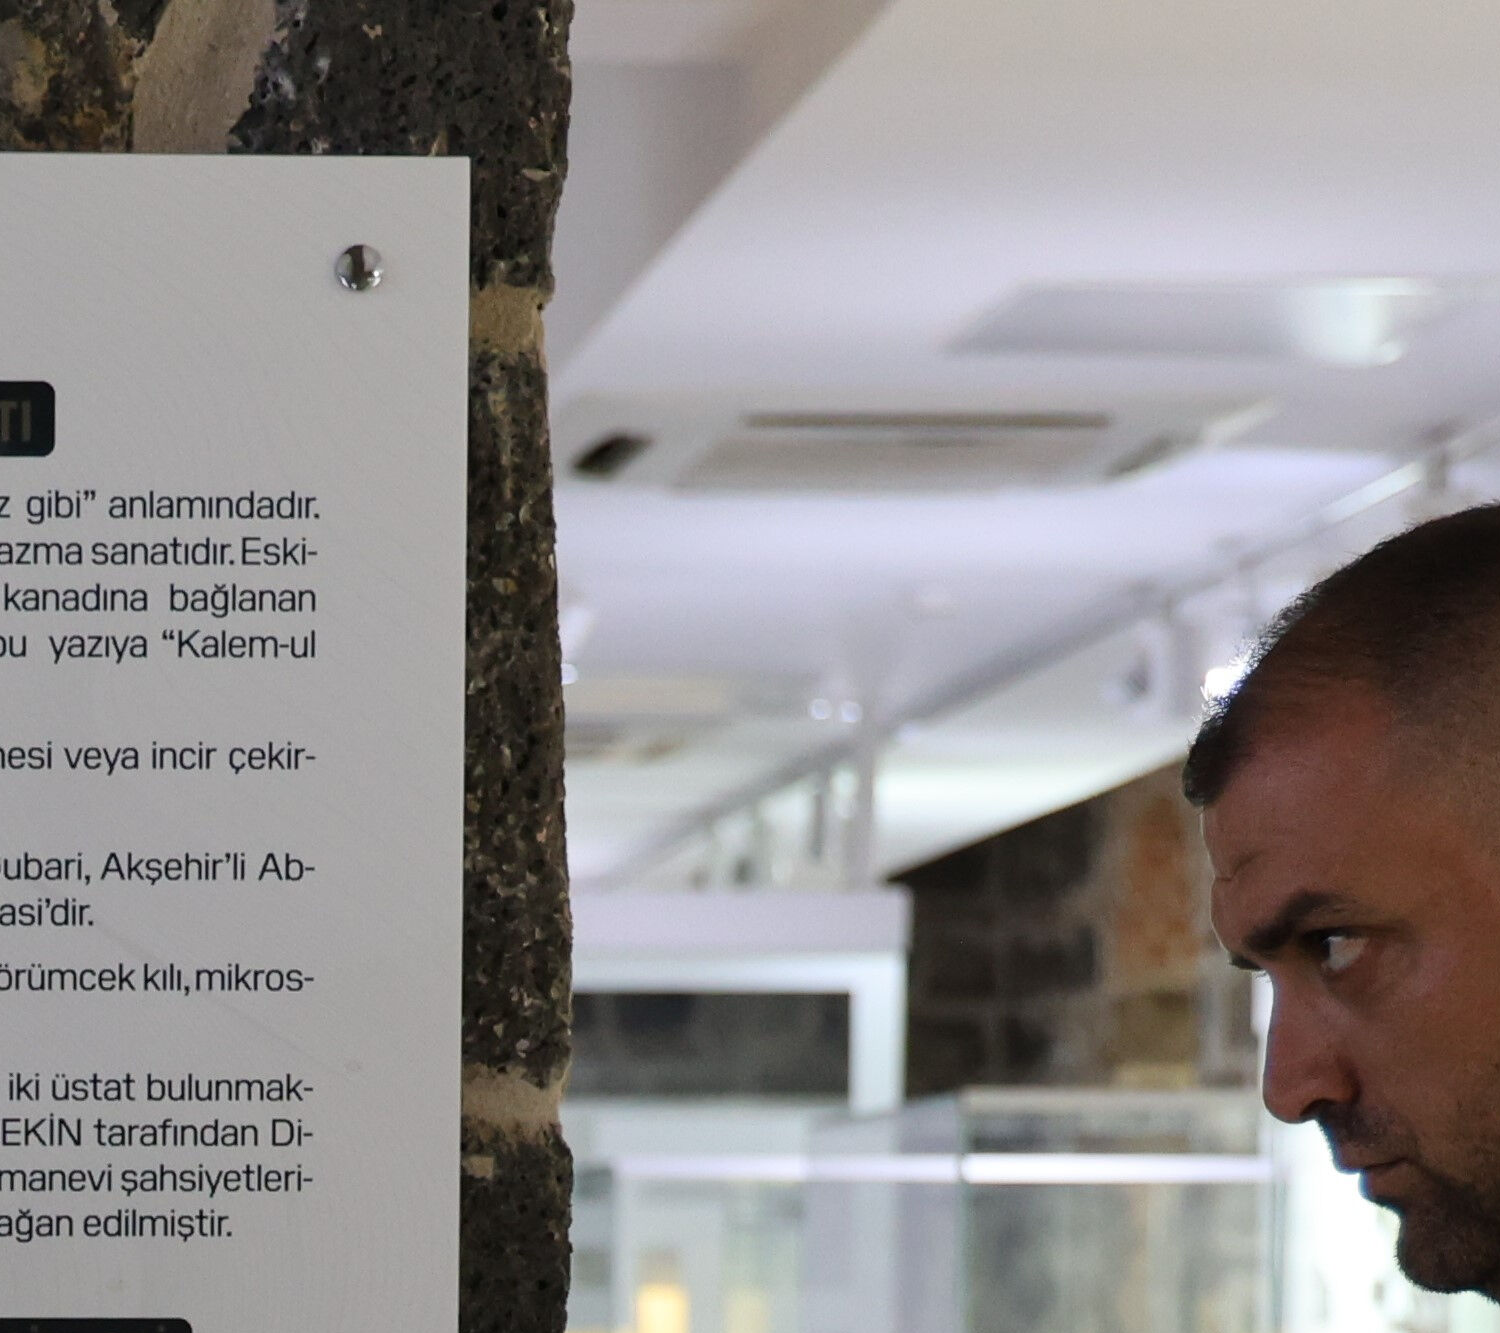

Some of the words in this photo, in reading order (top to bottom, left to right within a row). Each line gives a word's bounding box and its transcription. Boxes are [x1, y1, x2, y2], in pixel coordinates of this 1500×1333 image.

[107, 489, 321, 521] anlamındadır.
[90, 535, 236, 567] sanatıdır.
[240, 535, 319, 567] Eski-
[47, 634, 148, 665] yazıya
[63, 746, 140, 777] veya
[151, 740, 218, 771] incir
[228, 740, 317, 776] çekir-
[257, 851, 316, 882] Ab-
[143, 962, 191, 997] kılı,
[194, 962, 315, 993] mikros-
[8, 1071, 41, 1102] iki
[50, 1071, 137, 1103] üstat
[146, 1072, 314, 1103] bulunmak-
[92, 1117, 259, 1148] tarafından
[271, 1117, 314, 1148] Di-
[82, 1207, 233, 1243] edilmiştir.
